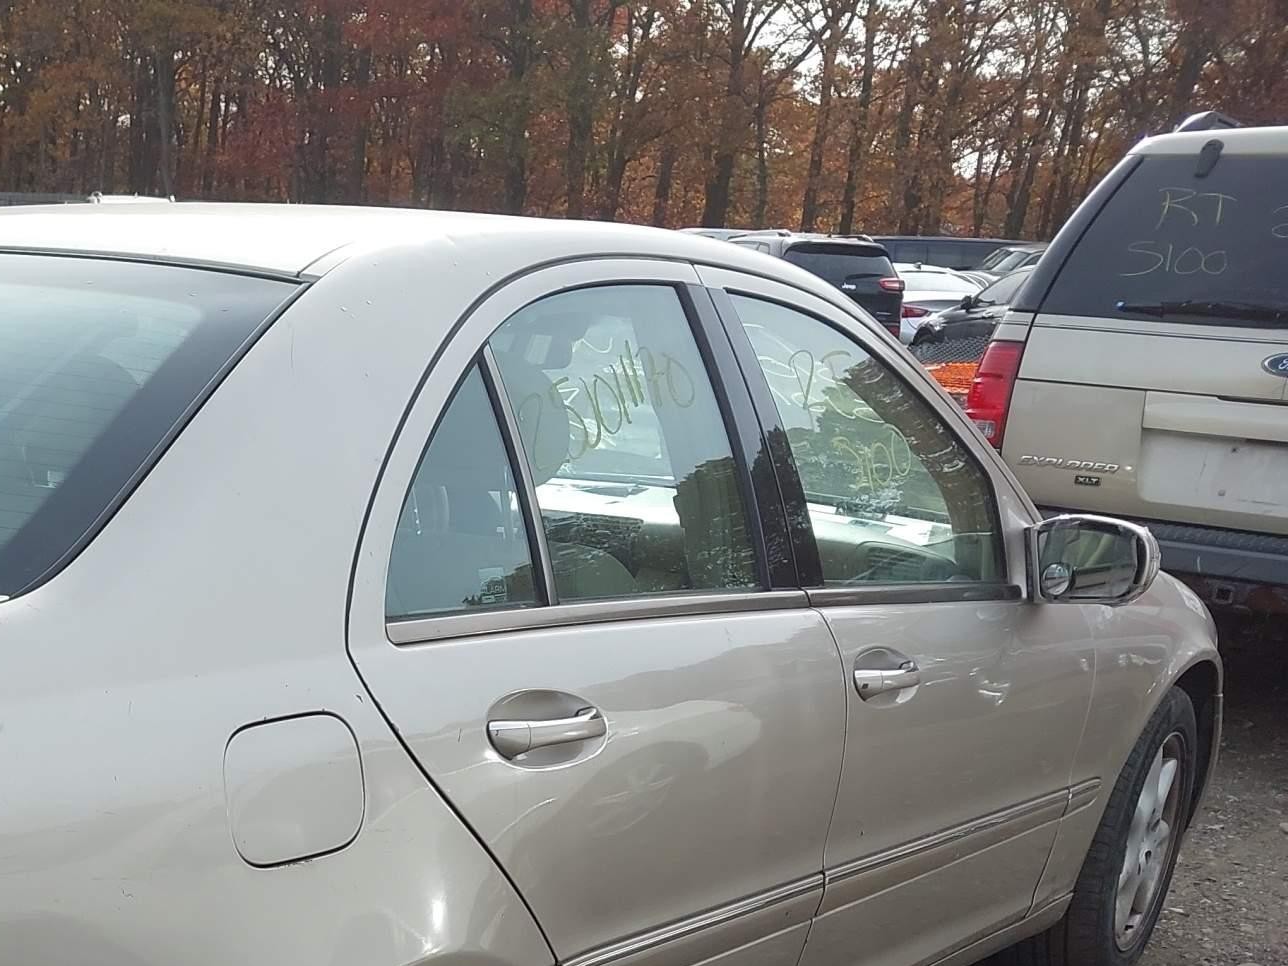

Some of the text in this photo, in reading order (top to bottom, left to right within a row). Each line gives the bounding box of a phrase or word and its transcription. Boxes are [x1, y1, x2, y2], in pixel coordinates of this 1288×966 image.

[1155, 187, 1238, 230] RT
[841, 282, 857, 290] Jeep
[1017, 454, 1121, 474] EXPLORER
[1075, 475, 1100, 486] XLT
